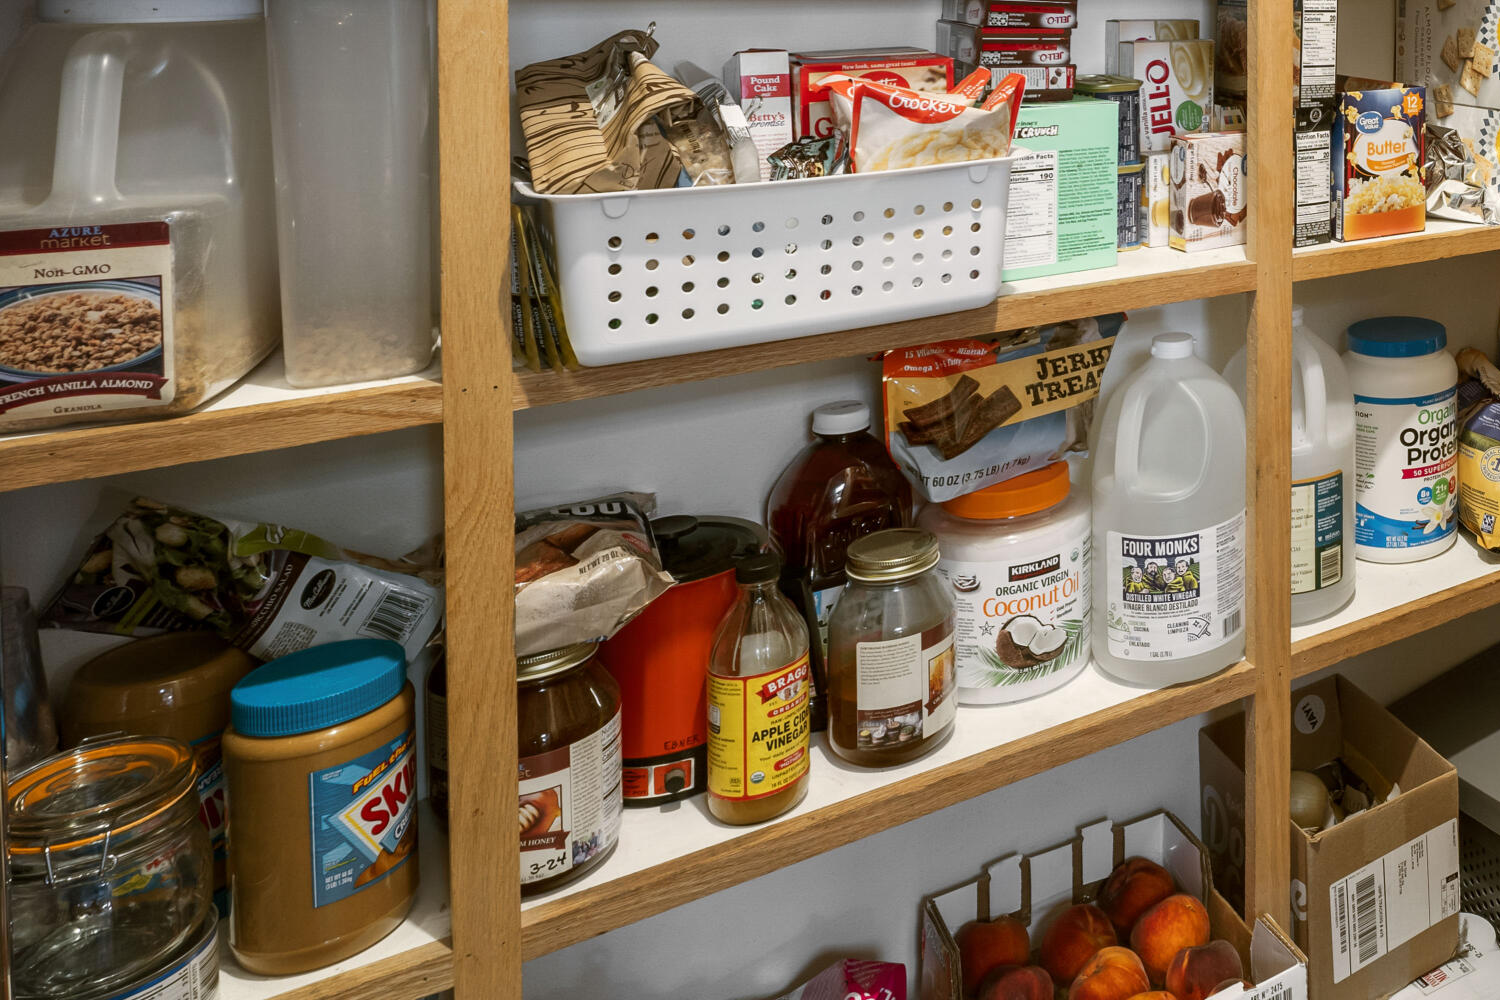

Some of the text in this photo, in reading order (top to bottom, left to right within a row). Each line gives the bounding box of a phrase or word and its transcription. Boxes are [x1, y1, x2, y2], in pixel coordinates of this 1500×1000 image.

[750, 76, 780, 86] Pound
[753, 84, 777, 93] Cake
[1145, 59, 1176, 137] JELL-O
[1407, 96, 1417, 108] 12
[750, 112, 785, 122] Betty's
[1359, 116, 1380, 126] Great
[1367, 141, 1407, 156] Butter
[49, 226, 103, 239] AZURE
[40, 233, 111, 250] market
[34, 263, 112, 280] Non-GMO
[48, 377, 153, 394] VANILLA ALMOND
[932, 473, 959, 488] 60 OZ
[1413, 469, 1422, 477] 50
[1123, 537, 1198, 557] FOUR MONKS
[1011, 556, 1059, 576] KIRKLAND
[995, 569, 1069, 597] ORGANIC VIRGIN
[983, 571, 1079, 618] Coconut Oil
[1153, 590, 1197, 602] WHITE VINEGAR
[1145, 602, 1168, 612] BLANCO
[1168, 599, 1198, 611] DESTILADO
[752, 721, 791, 743] APPLE
[766, 721, 808, 751] VINEGAR
[352, 761, 388, 795] FUEL
[529, 836, 556, 846] HONEY
[530, 852, 567, 875] 3-24
[1270, 982, 1283, 994] 2475
